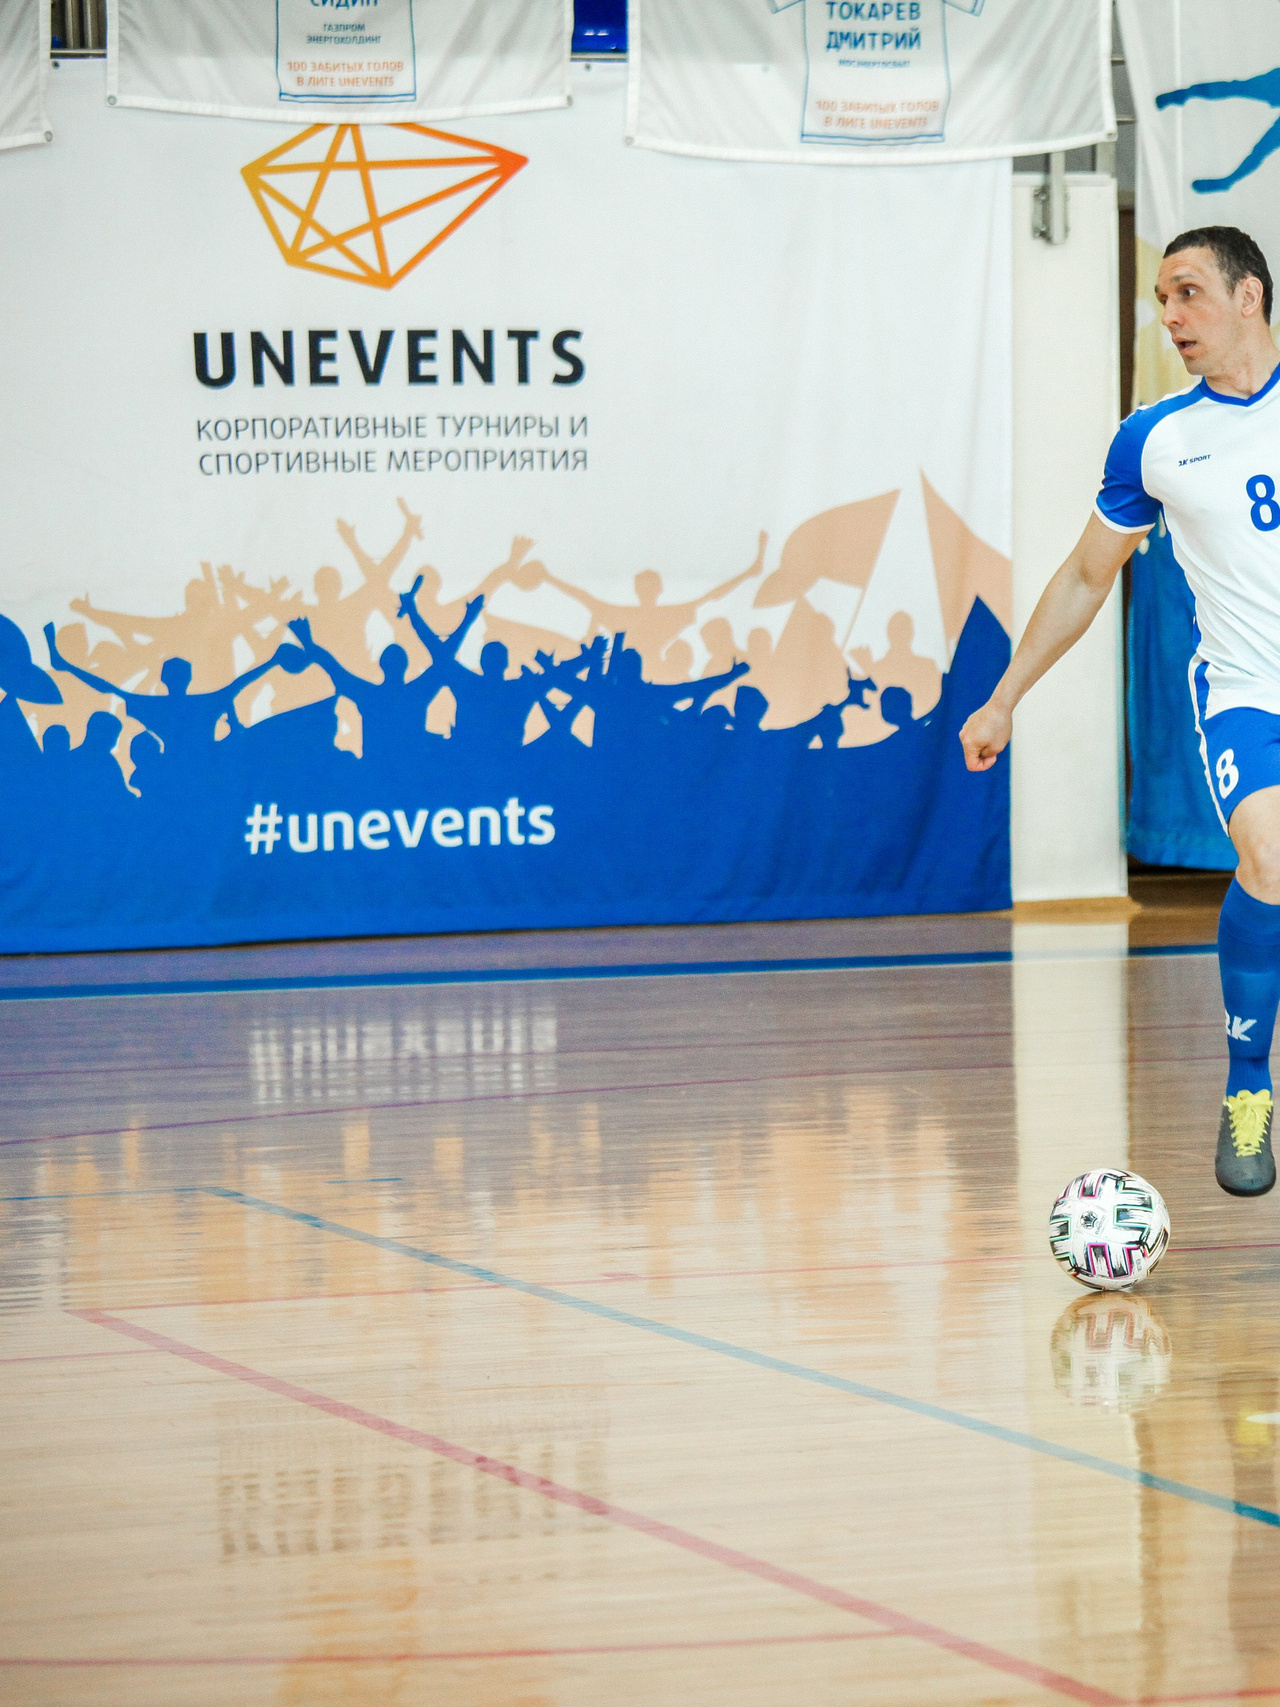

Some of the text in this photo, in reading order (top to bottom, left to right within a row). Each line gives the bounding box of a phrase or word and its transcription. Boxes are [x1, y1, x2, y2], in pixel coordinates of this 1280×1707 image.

[826, 2, 921, 21] ТОКАРЕВ
[323, 23, 366, 32] ГАЗПРОМ
[826, 27, 922, 52] ДМИТРИЙ
[288, 61, 404, 73] 100 ЗАБИТЫХ ГОЛОВ
[308, 76, 335, 87] ЛИГЕ
[339, 76, 394, 87] UNEVENTS
[193, 329, 586, 389] UNEVENTS
[197, 415, 588, 441] КОРПОРАТИВНЫЕ ТУРНИРЫ И
[200, 449, 588, 475] СПОРТИВНЫЕ МЕРОПРИЯТИЯ
[1189, 454, 1211, 464] SPORT
[1216, 748, 1239, 799] 8
[245, 797, 555, 855] #unevents
